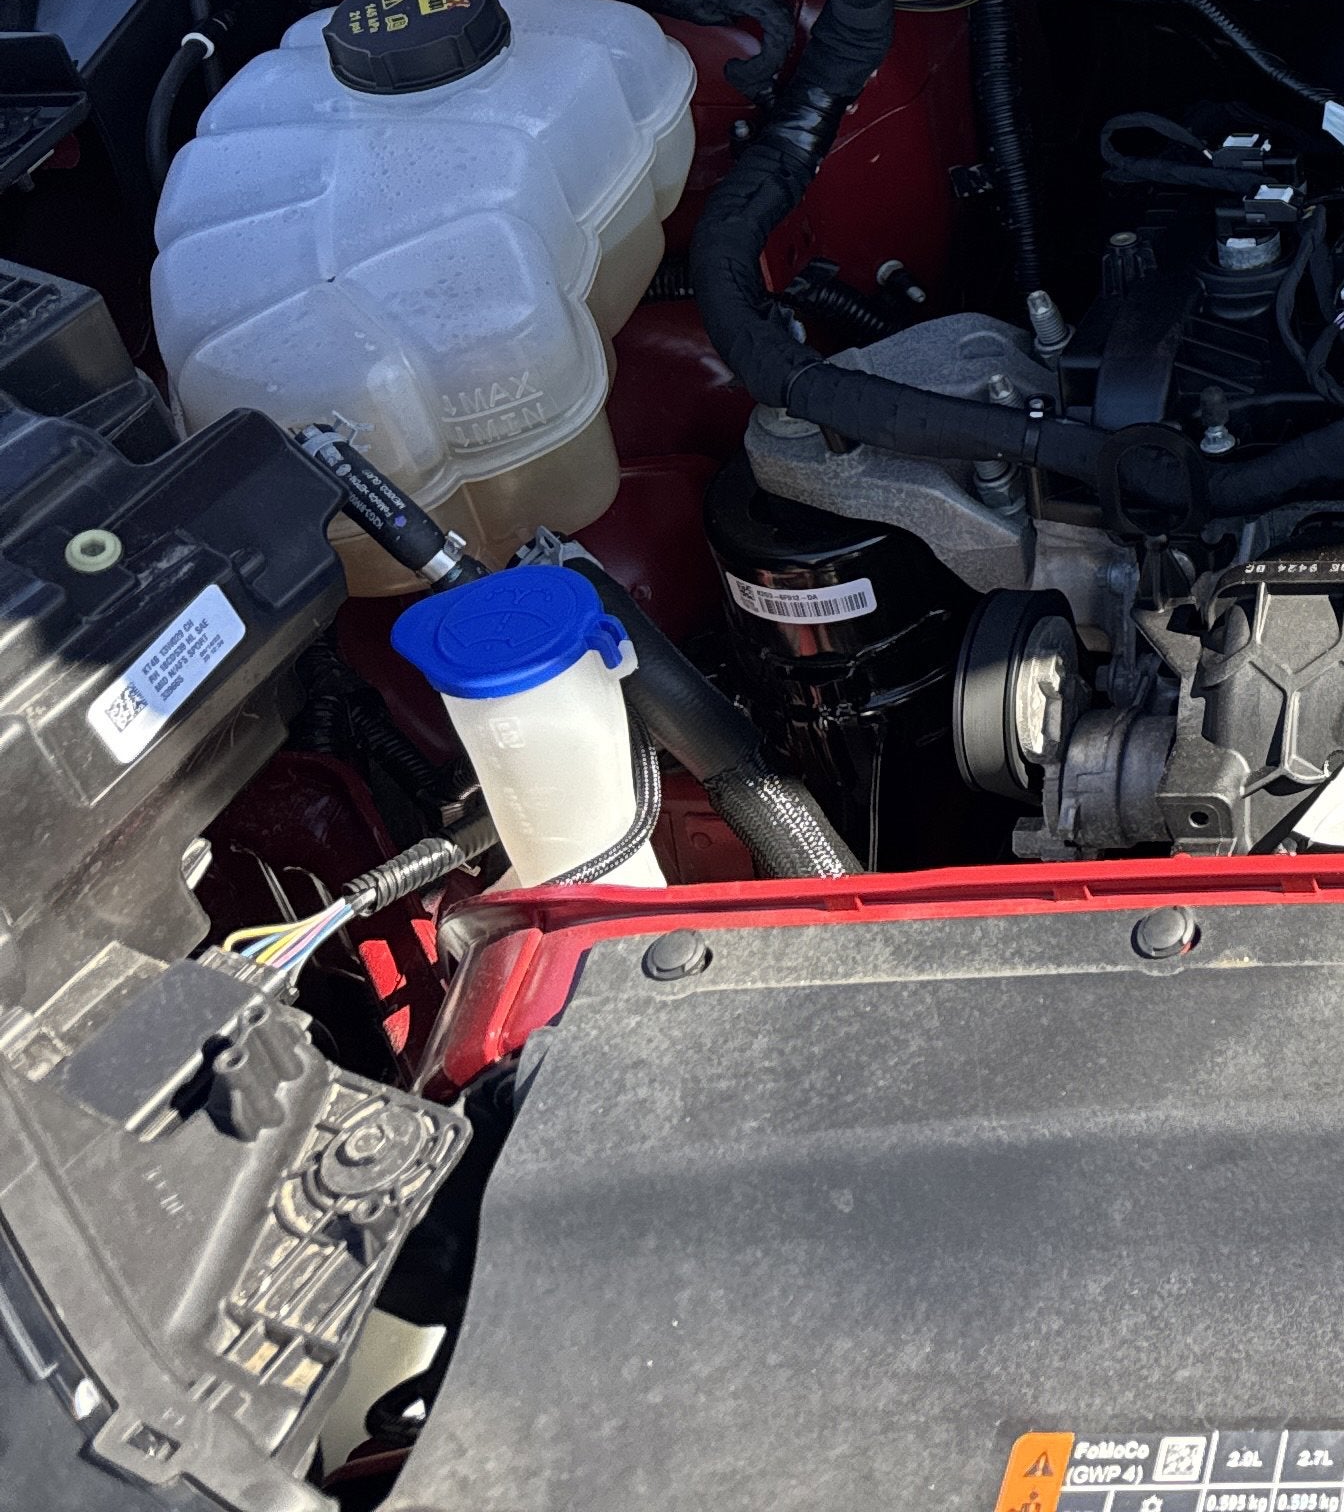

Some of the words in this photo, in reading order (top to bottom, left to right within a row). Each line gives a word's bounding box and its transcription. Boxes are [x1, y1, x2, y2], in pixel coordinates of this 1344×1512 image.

[459, 371, 536, 414] MAX
[472, 402, 547, 444] MIN
[1074, 1440, 1150, 1460] FoMoCo
[1296, 1448, 1334, 1466] 2.7L
[1066, 1465, 1121, 1486] (GWP
[1121, 1465, 1144, 1486] 4)
